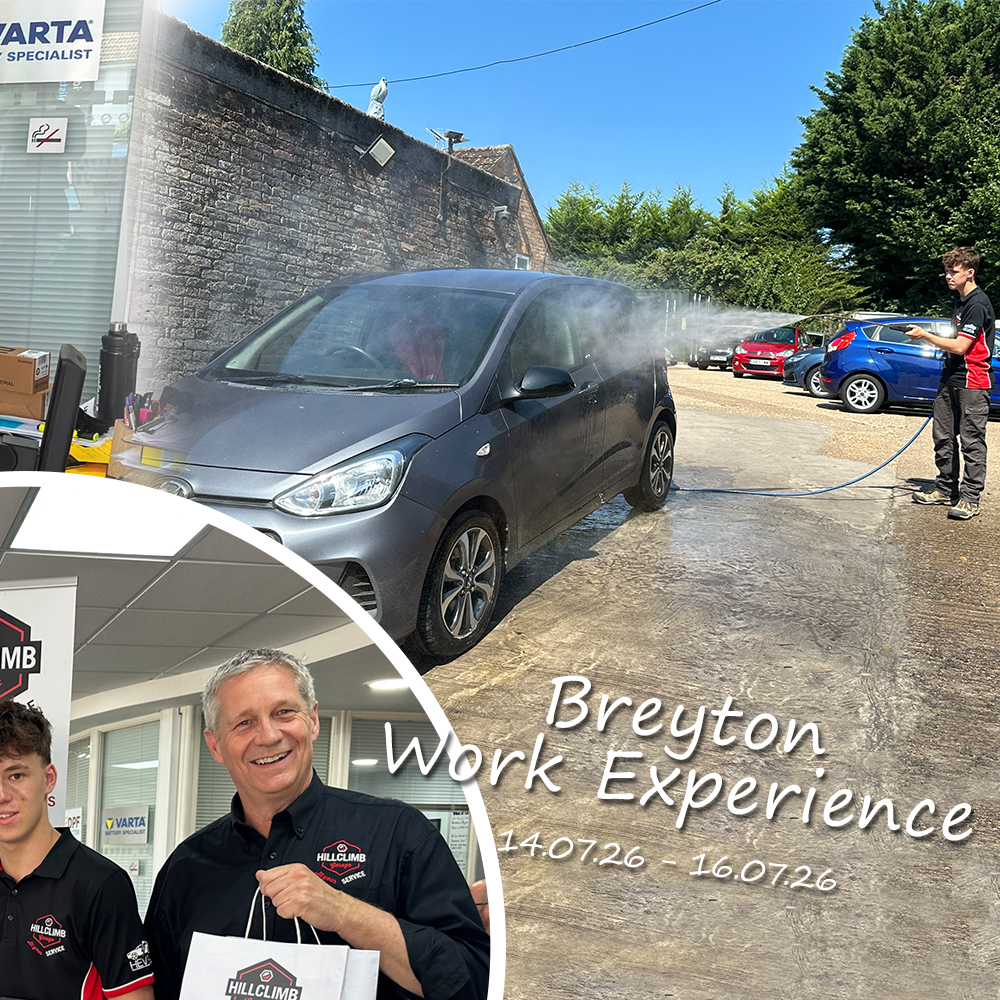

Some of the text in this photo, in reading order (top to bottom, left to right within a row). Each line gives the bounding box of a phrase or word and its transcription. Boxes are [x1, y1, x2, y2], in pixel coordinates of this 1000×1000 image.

[7, 49, 92, 62] SPECIALIST
[116, 817, 146, 828] VARTA
[317, 853, 366, 862] HILLCLIMB
[341, 870, 366, 884] SERVICE
[30, 923, 66, 938] HILLCLIMB
[45, 945, 65, 957] SERVICE
